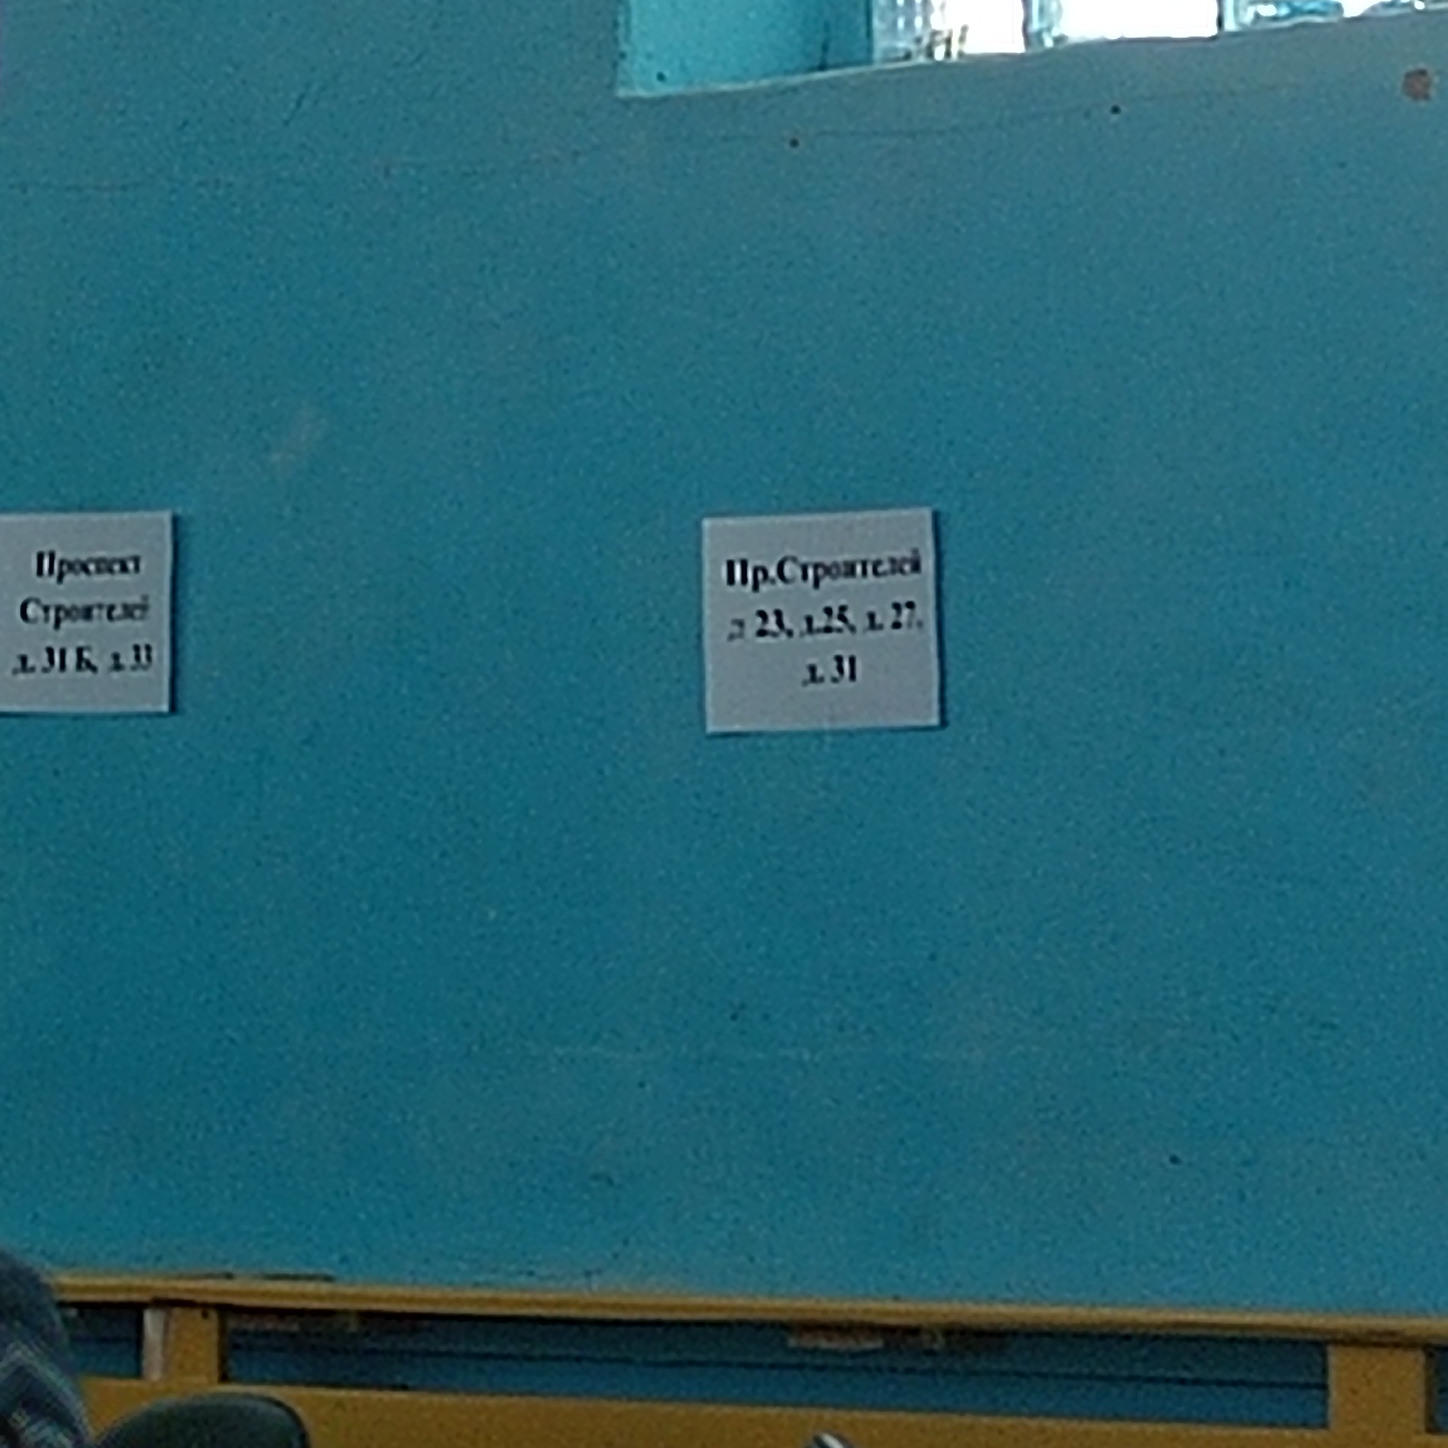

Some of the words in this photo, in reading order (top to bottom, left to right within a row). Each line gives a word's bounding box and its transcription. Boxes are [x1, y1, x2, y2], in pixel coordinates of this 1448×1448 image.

[35, 550, 141, 585] Проспект
[19, 594, 151, 631] Строителей
[829, 654, 857, 684] 31
